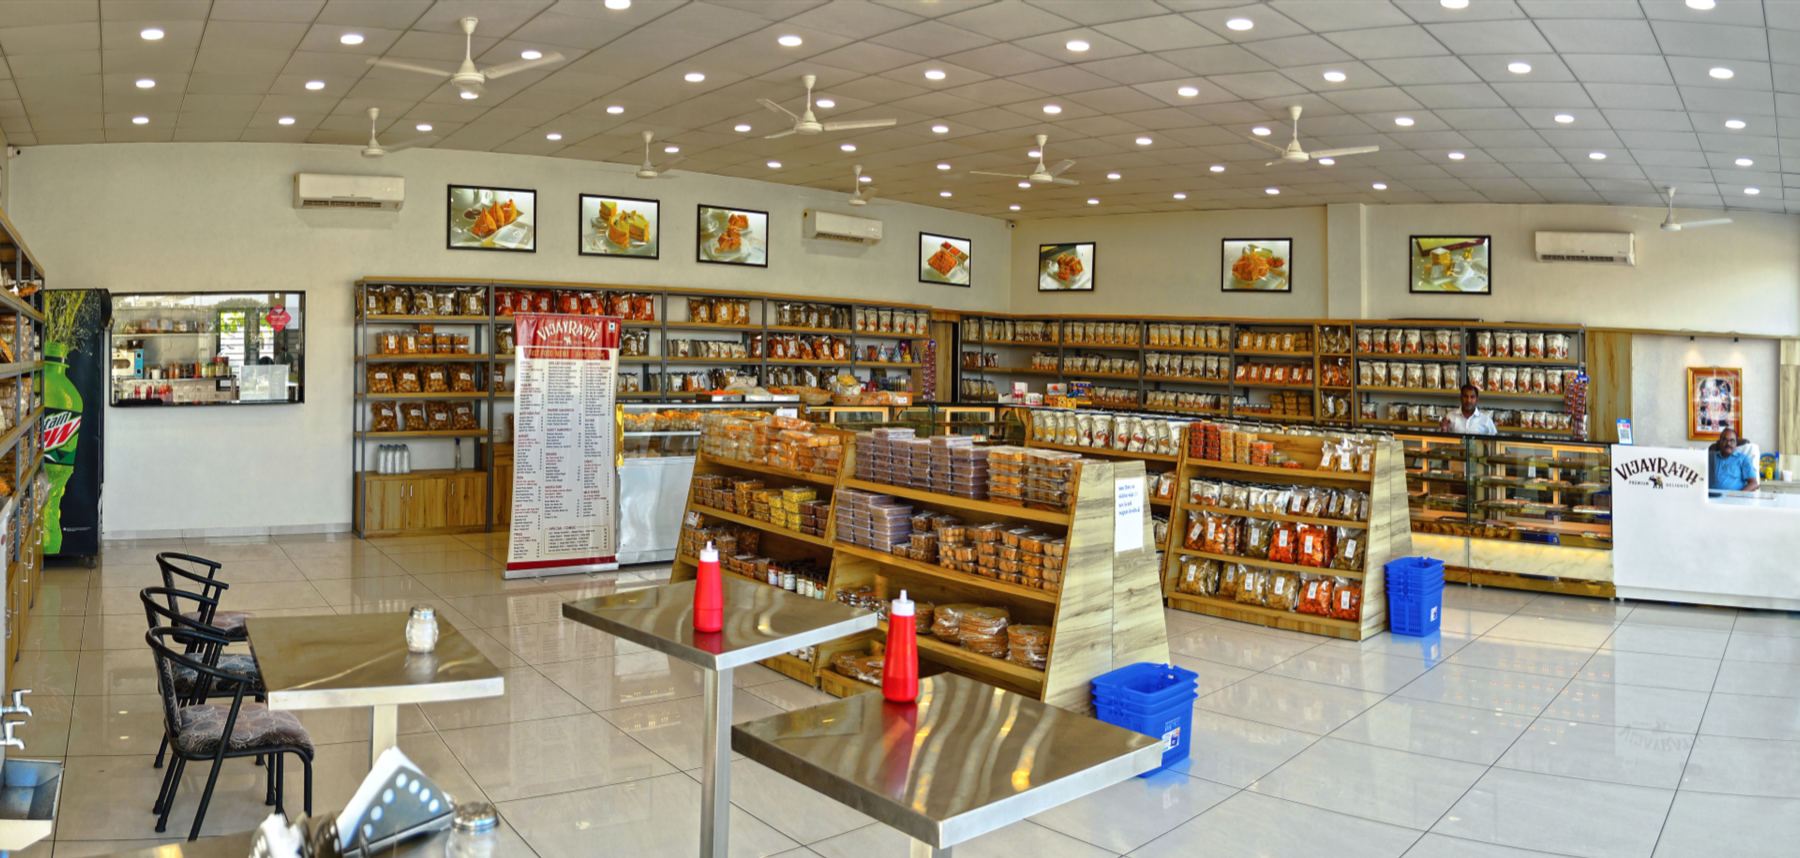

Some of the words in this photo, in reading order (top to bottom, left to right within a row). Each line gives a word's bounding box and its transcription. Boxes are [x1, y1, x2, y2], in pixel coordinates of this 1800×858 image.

[536, 320, 598, 342] VIJAYRATH
[44, 413, 70, 430] tain
[1614, 457, 1699, 486] VIJAYRATH
